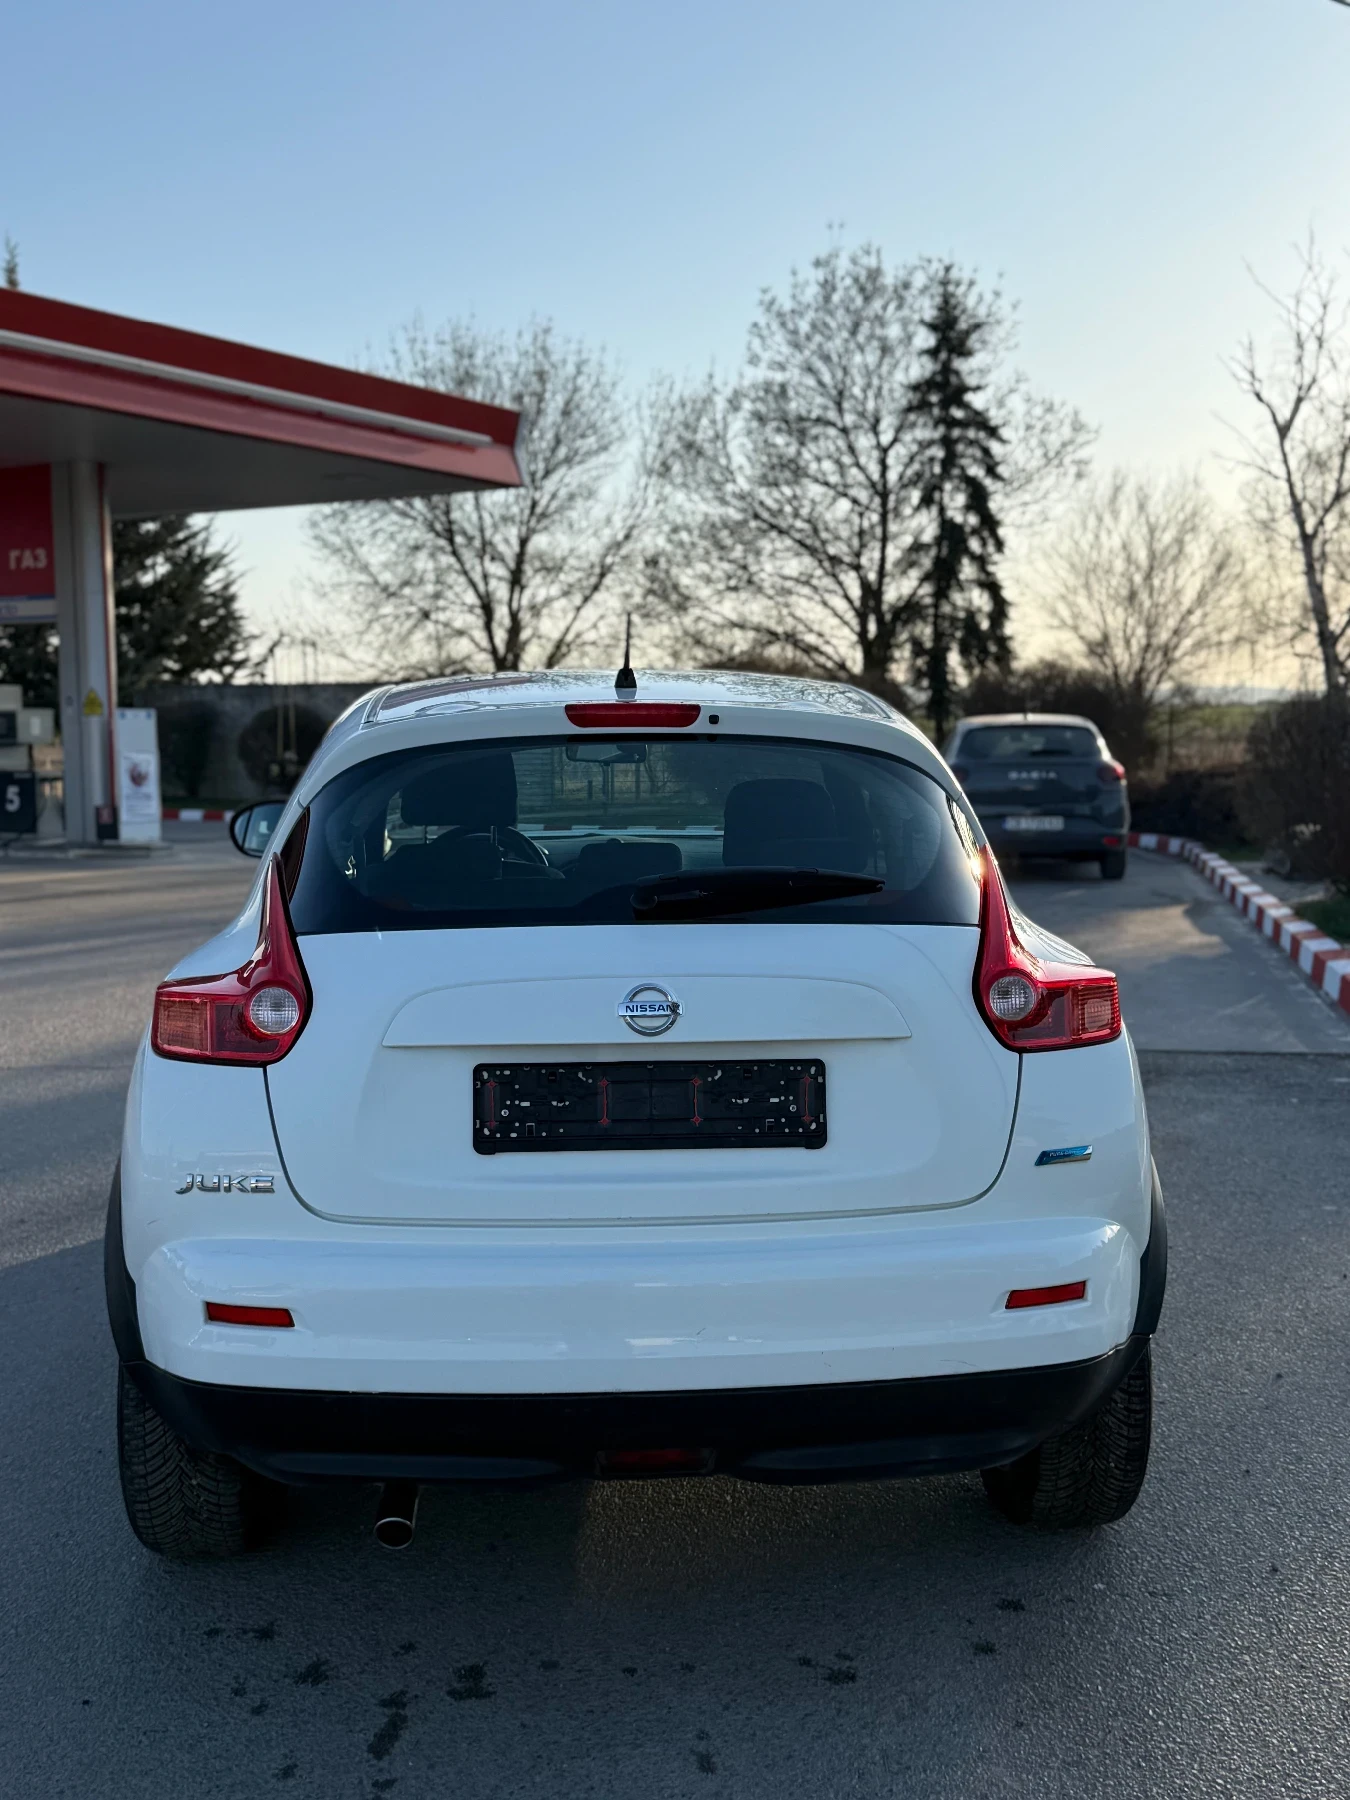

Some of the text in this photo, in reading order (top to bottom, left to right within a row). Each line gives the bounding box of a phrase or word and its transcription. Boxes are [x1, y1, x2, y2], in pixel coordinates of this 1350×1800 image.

[8, 548, 48, 570] ГАЗ
[5, 784, 21, 812] 5
[625, 1004, 675, 1013] NISSAN
[175, 1173, 275, 1194] JUKE
